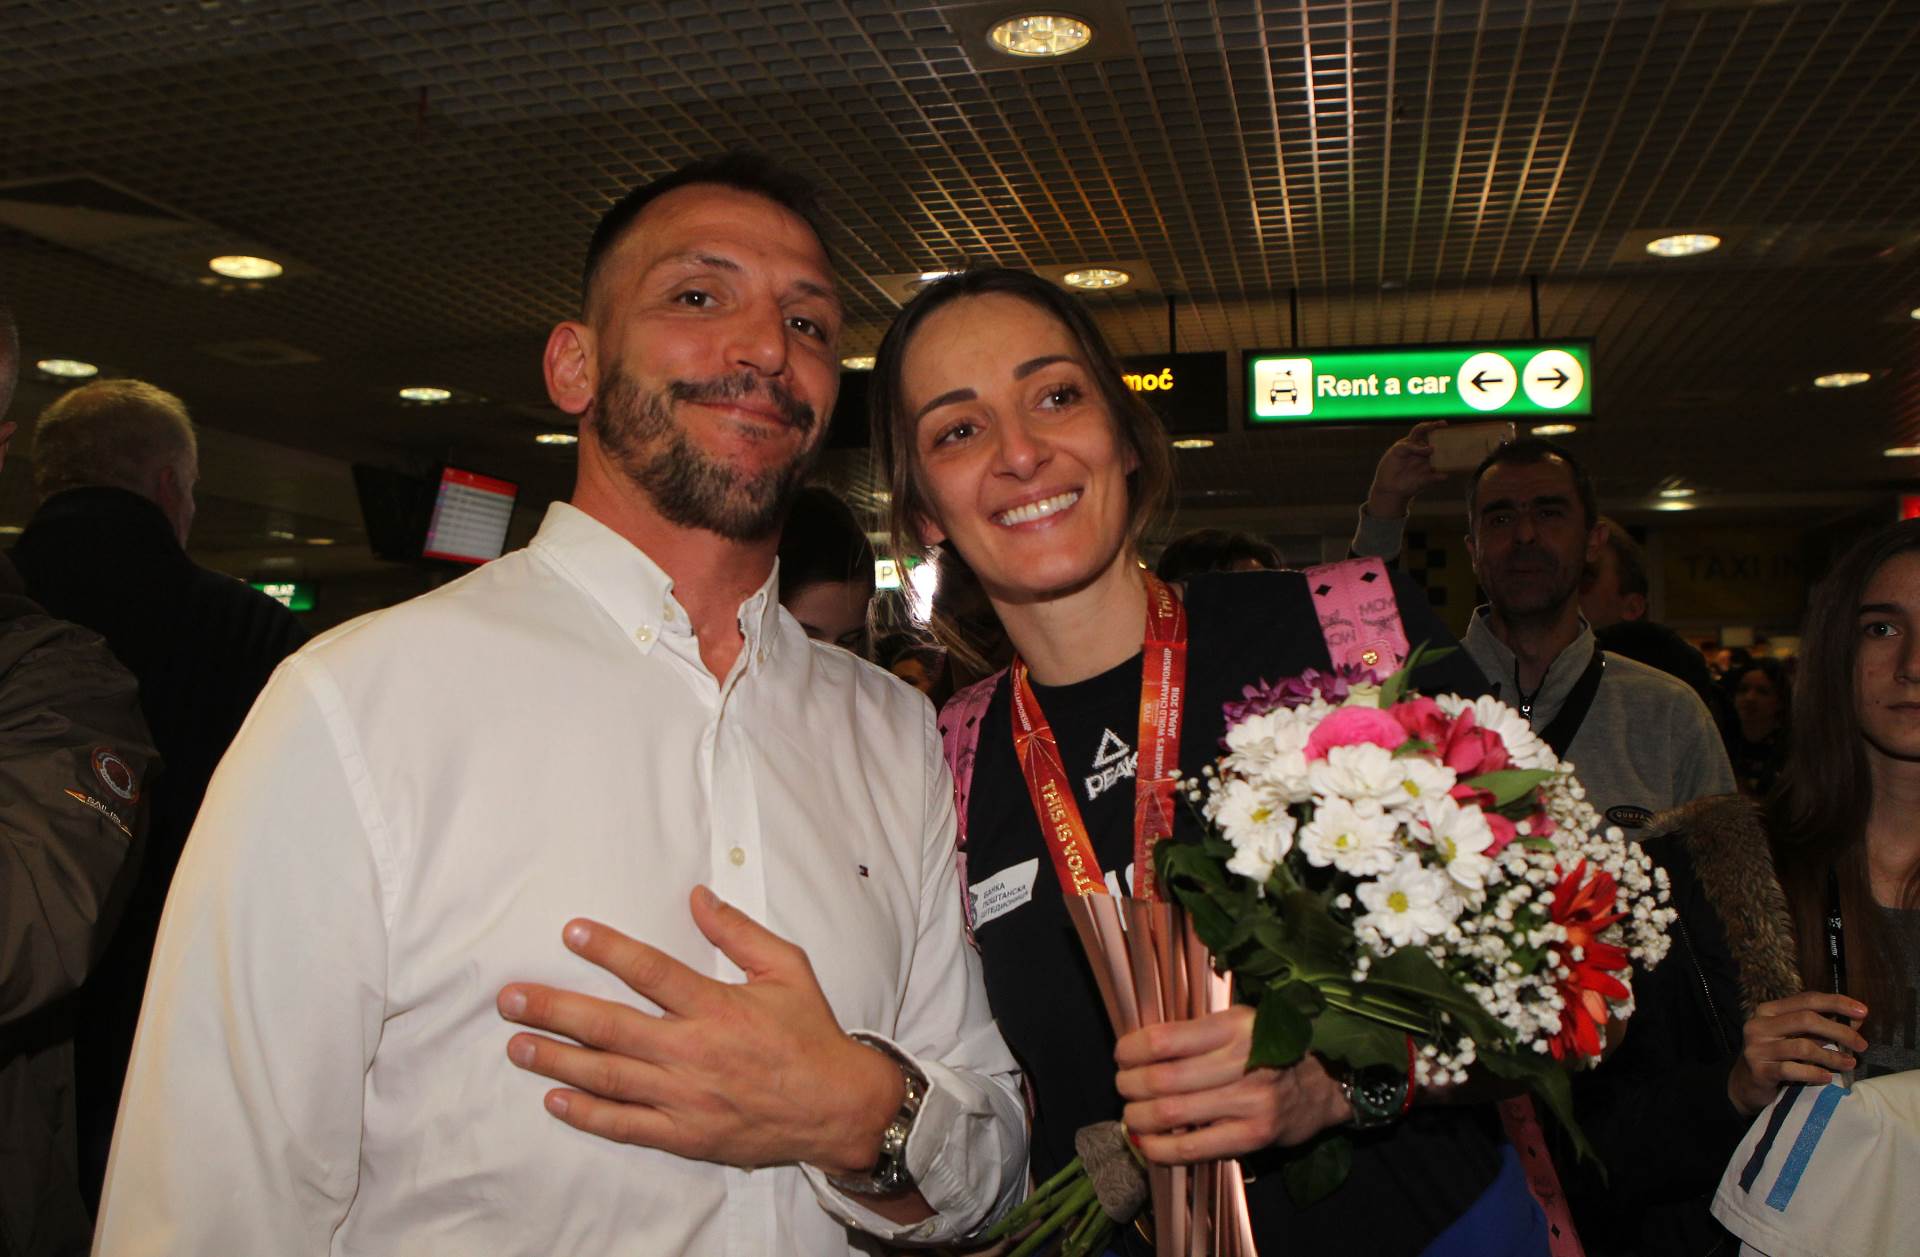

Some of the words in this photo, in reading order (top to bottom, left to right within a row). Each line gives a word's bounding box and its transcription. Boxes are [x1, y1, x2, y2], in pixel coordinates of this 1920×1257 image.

[1317, 374, 1379, 397] Rent
[1385, 378, 1401, 396] a
[1408, 376, 1452, 395] car
[881, 566, 894, 580] P
[1684, 553, 1762, 581] TAXI
[1159, 647, 1172, 709] CHAMPIONSHIP
[1170, 687, 1180, 707] 2018
[1157, 709, 1167, 736] WORLD
[1168, 709, 1179, 739] JAPAN
[1153, 738, 1165, 780] WOMEN'S
[1041, 779, 1066, 823] THIS
[1056, 823, 1073, 842] IS
